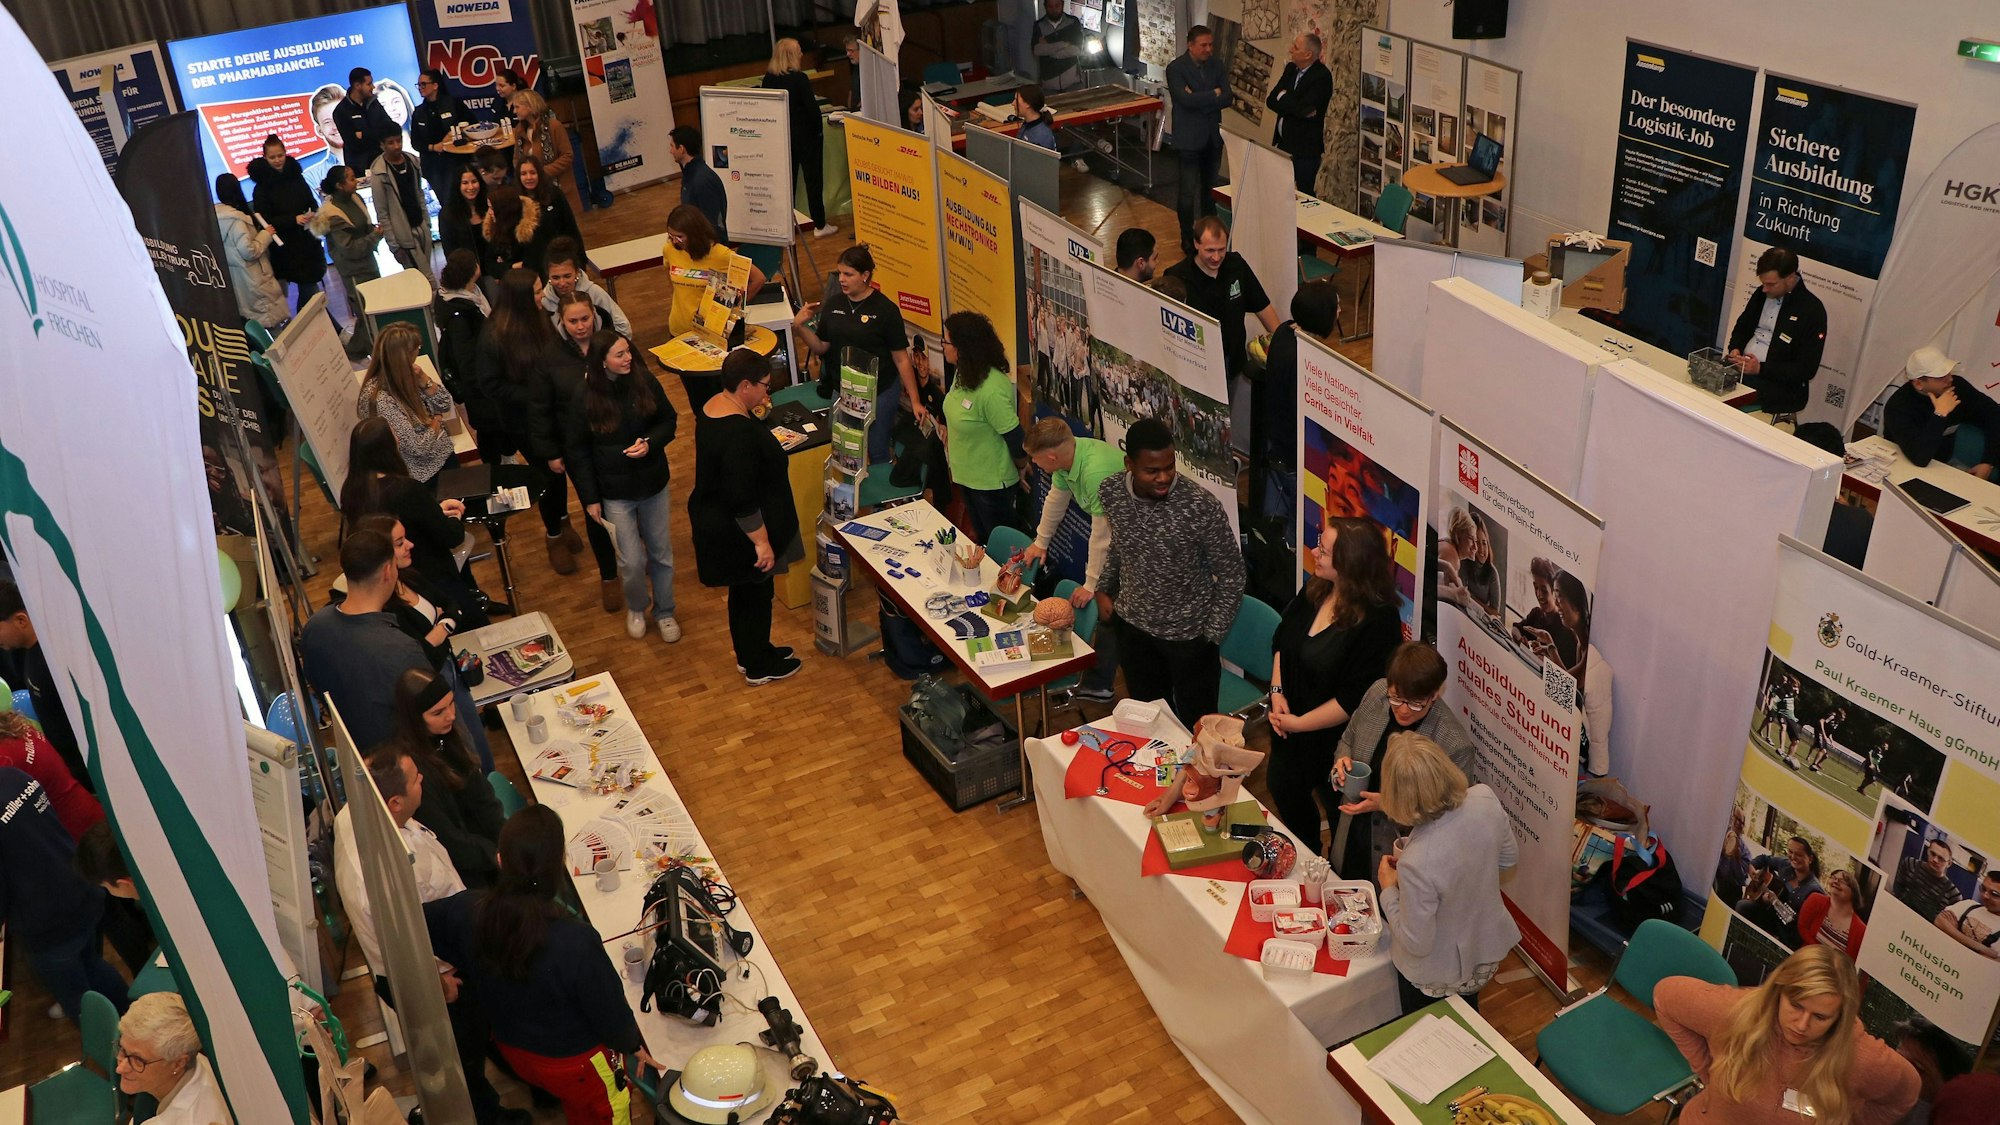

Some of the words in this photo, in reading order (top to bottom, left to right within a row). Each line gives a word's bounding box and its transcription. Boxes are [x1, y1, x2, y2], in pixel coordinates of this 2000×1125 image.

[447, 1, 500, 14] NOWEDA
[187, 57, 232, 75] STARTE
[235, 50, 271, 66] DEINE
[273, 37, 347, 60] AUSBILDUNG
[349, 34, 364, 46] IN
[192, 75, 217, 89] DER
[219, 56, 324, 84] PHARMABRANCHE.
[428, 38, 540, 90] NOW
[122, 86, 139, 97] FÜR
[1630, 89, 1657, 110] Der
[1660, 96, 1736, 131] besondere
[1628, 110, 1715, 148] Logistik-Job
[1769, 127, 1840, 162] Sichere
[900, 146, 919, 158] DHL
[855, 169, 871, 184] WIR
[872, 174, 900, 194] BILDEN
[901, 185, 920, 202] AUS!
[983, 190, 999, 204] DHL
[1764, 154, 1874, 204] Ausbildung
[946, 197, 984, 230] AUSBILDUNG
[986, 221, 997, 238] ALS
[1759, 192, 1771, 209] in
[1777, 197, 1840, 233] Richtung
[1941, 200, 1969, 209] LOGISTICS
[946, 212, 998, 254] MECHATRONIKER
[947, 226, 974, 255] (M/W/D)
[1756, 212, 1811, 242] Zukunft
[1069, 240, 1085, 258] LVR
[33, 271, 95, 314] HOSPITAL
[46, 310, 104, 351] FRECHEN
[176, 314, 214, 352] OU
[1162, 310, 1187, 336] LVR
[1304, 359, 1323, 378] Viele
[1324, 371, 1361, 403] Nationen.
[1304, 375, 1323, 395] Viele
[1324, 388, 1362, 421] Gesichter.
[242, 408, 257, 420] DEN
[1304, 392, 1333, 418] Caritas
[1334, 411, 1342, 424] in
[1344, 417, 1375, 446] Vielfalt.
[1187, 459, 1222, 485] starten
[1482, 476, 1535, 519] Caritasverband
[1482, 489, 1491, 502] für
[1492, 498, 1506, 513] den
[1507, 508, 1564, 554] Rhein-Erft-Kreis
[1565, 550, 1581, 565] e.V.
[1458, 636, 1536, 716] Ausbildung
[1541, 709, 1571, 742] und
[1457, 675, 1500, 720] Pflegeschule
[1501, 716, 1527, 744] Caritas
[1528, 740, 1568, 779] Rhein-Erft
[1458, 660, 1501, 706] duales
[1507, 700, 1570, 764] Studium
[1815, 660, 1843, 683] Paul
[1846, 676, 1905, 715] Kraemer
[1908, 710, 1941, 739] Haus
[1945, 735, 2000, 771] gGmbH
[1470, 712, 1502, 747] Bachelor
[1503, 742, 1527, 770] Pflege
[1528, 766, 1535, 778] &
[1470, 724, 1516, 773] Management
[1517, 769, 1539, 793] (Start:
[1474, 746, 1549, 820] flegefachfrau/-mann
[1887, 943, 1964, 1001] gemeinsam
[1900, 930, 1960, 979] Inklusion
[1900, 967, 1940, 1003] leben!
